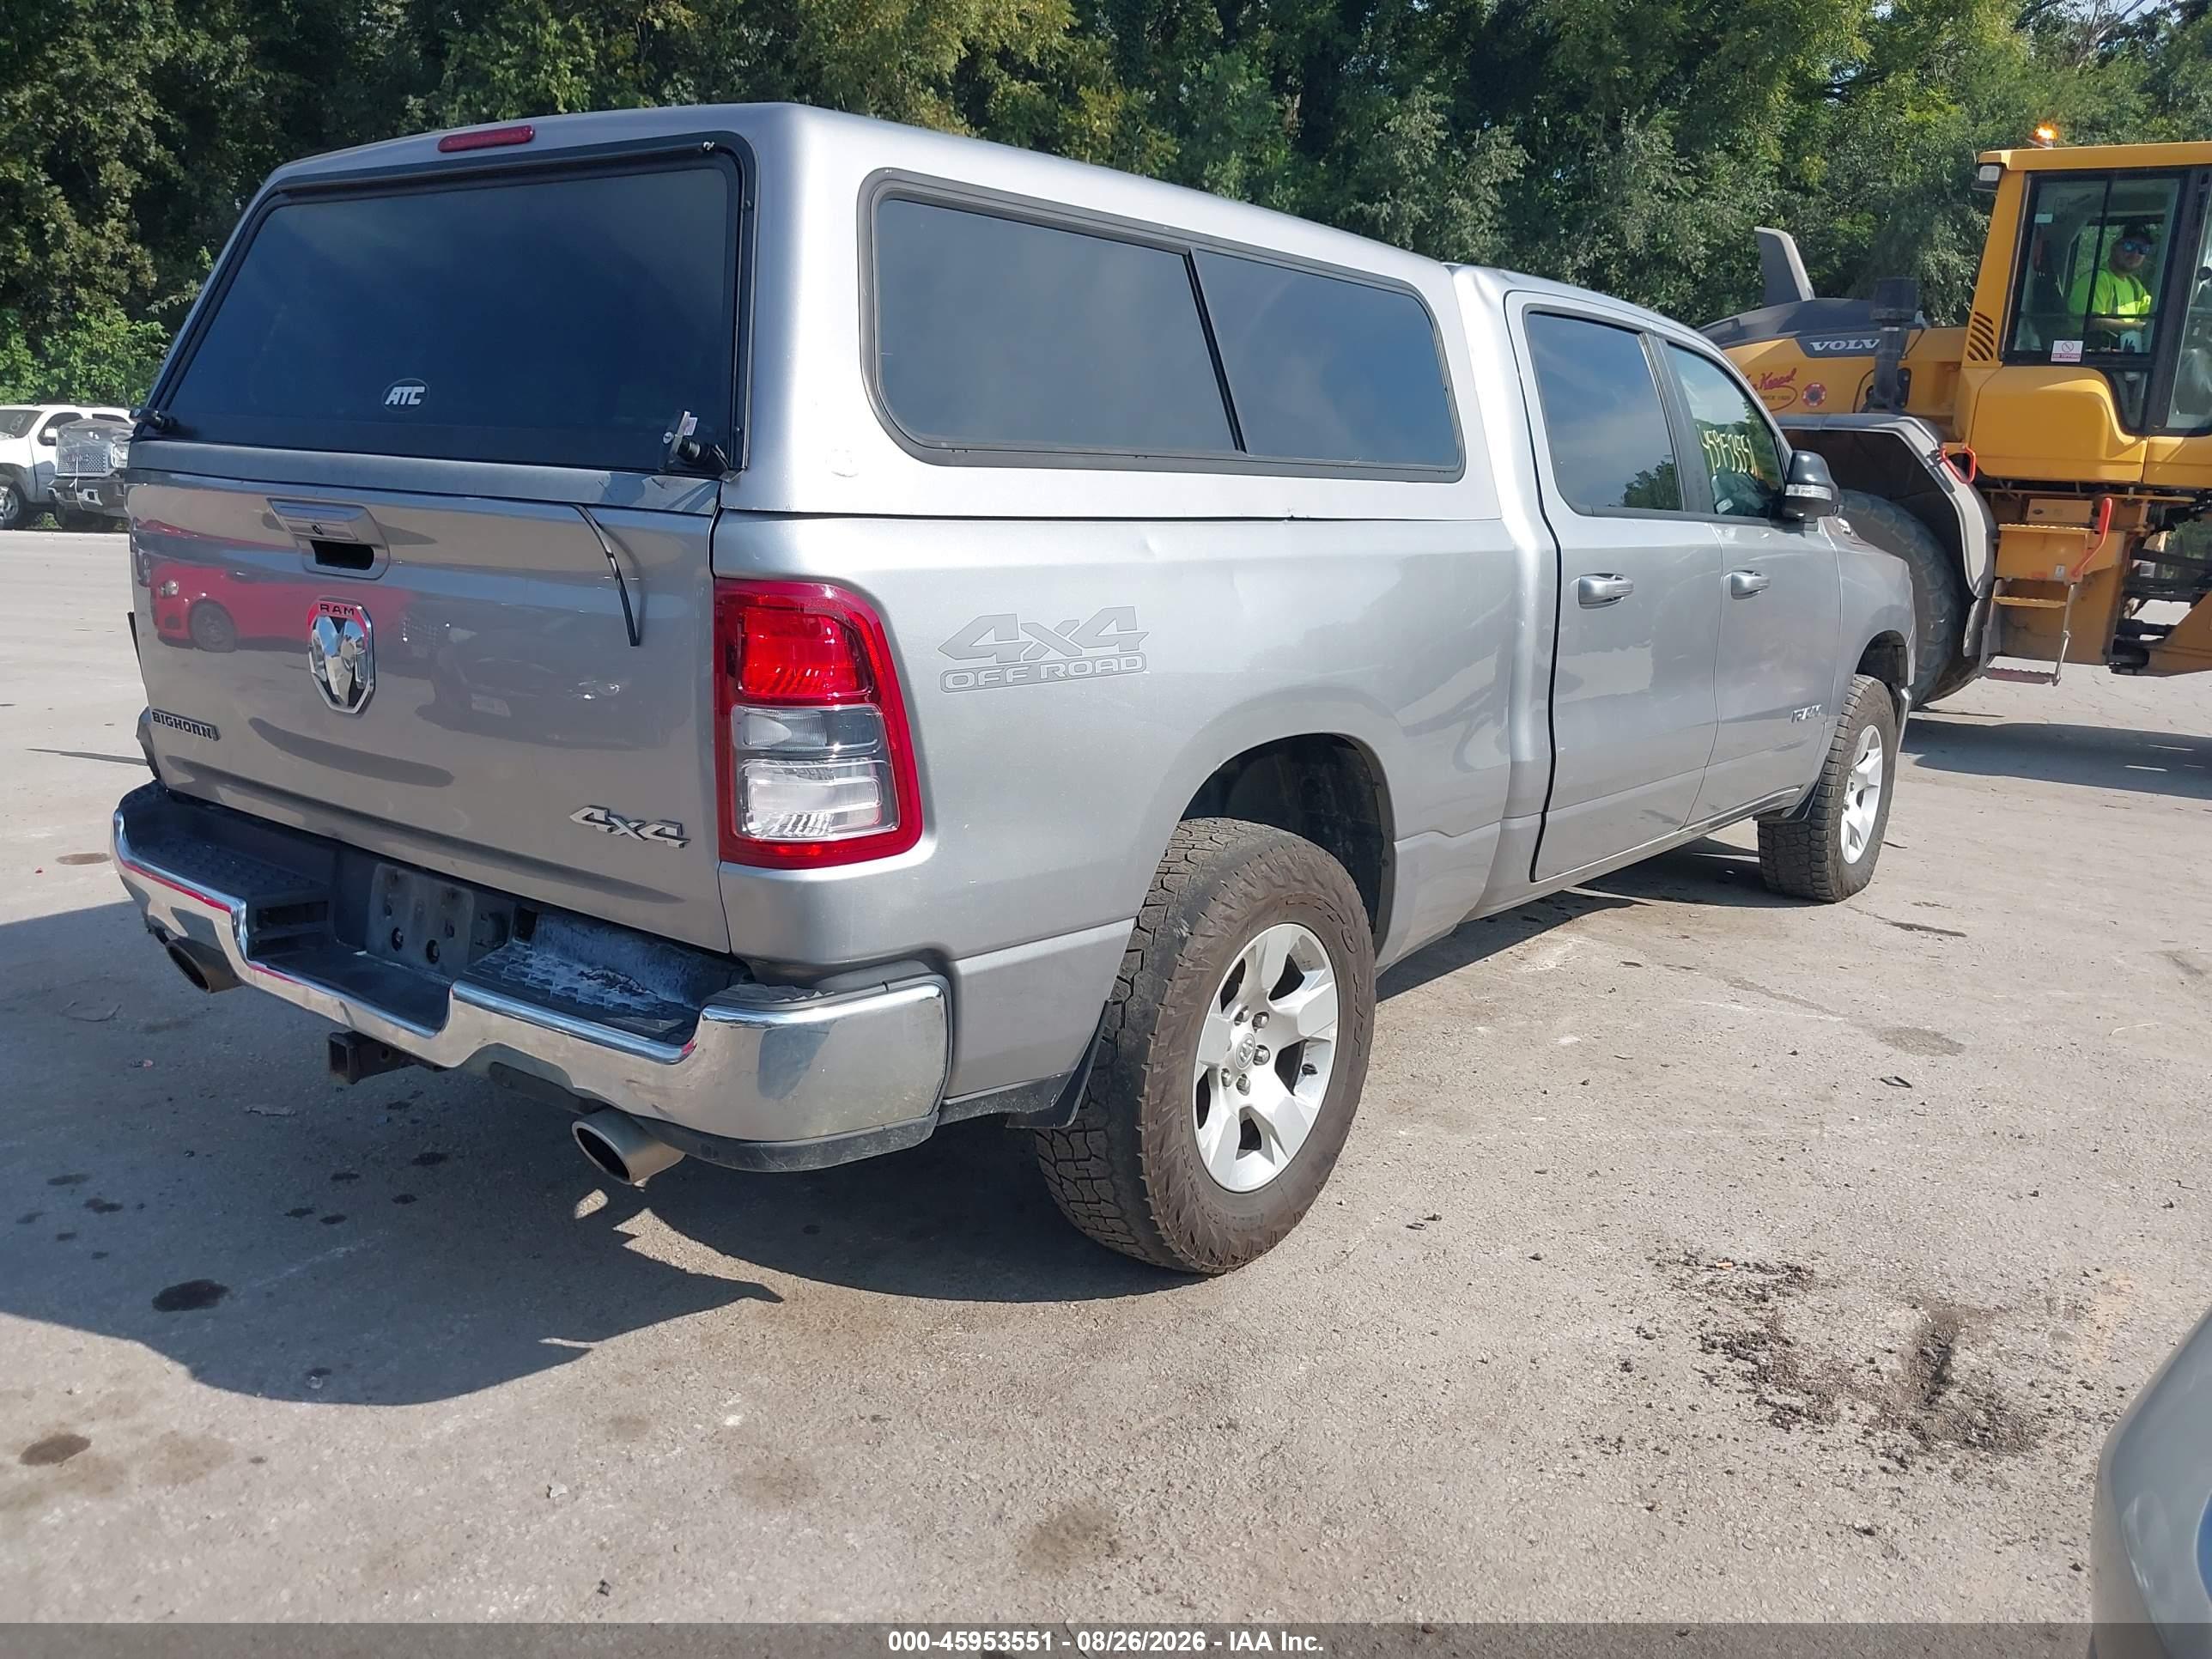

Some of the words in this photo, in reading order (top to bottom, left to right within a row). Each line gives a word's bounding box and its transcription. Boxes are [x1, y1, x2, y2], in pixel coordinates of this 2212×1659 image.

[1809, 339, 1880, 351] VOLV
[385, 386, 426, 405] ATC
[1696, 423, 1758, 477] 45953551
[319, 604, 355, 616] RAM
[945, 666, 1030, 689] OFF
[1039, 655, 1144, 680] ROAD
[152, 712, 213, 739] BIGHORN
